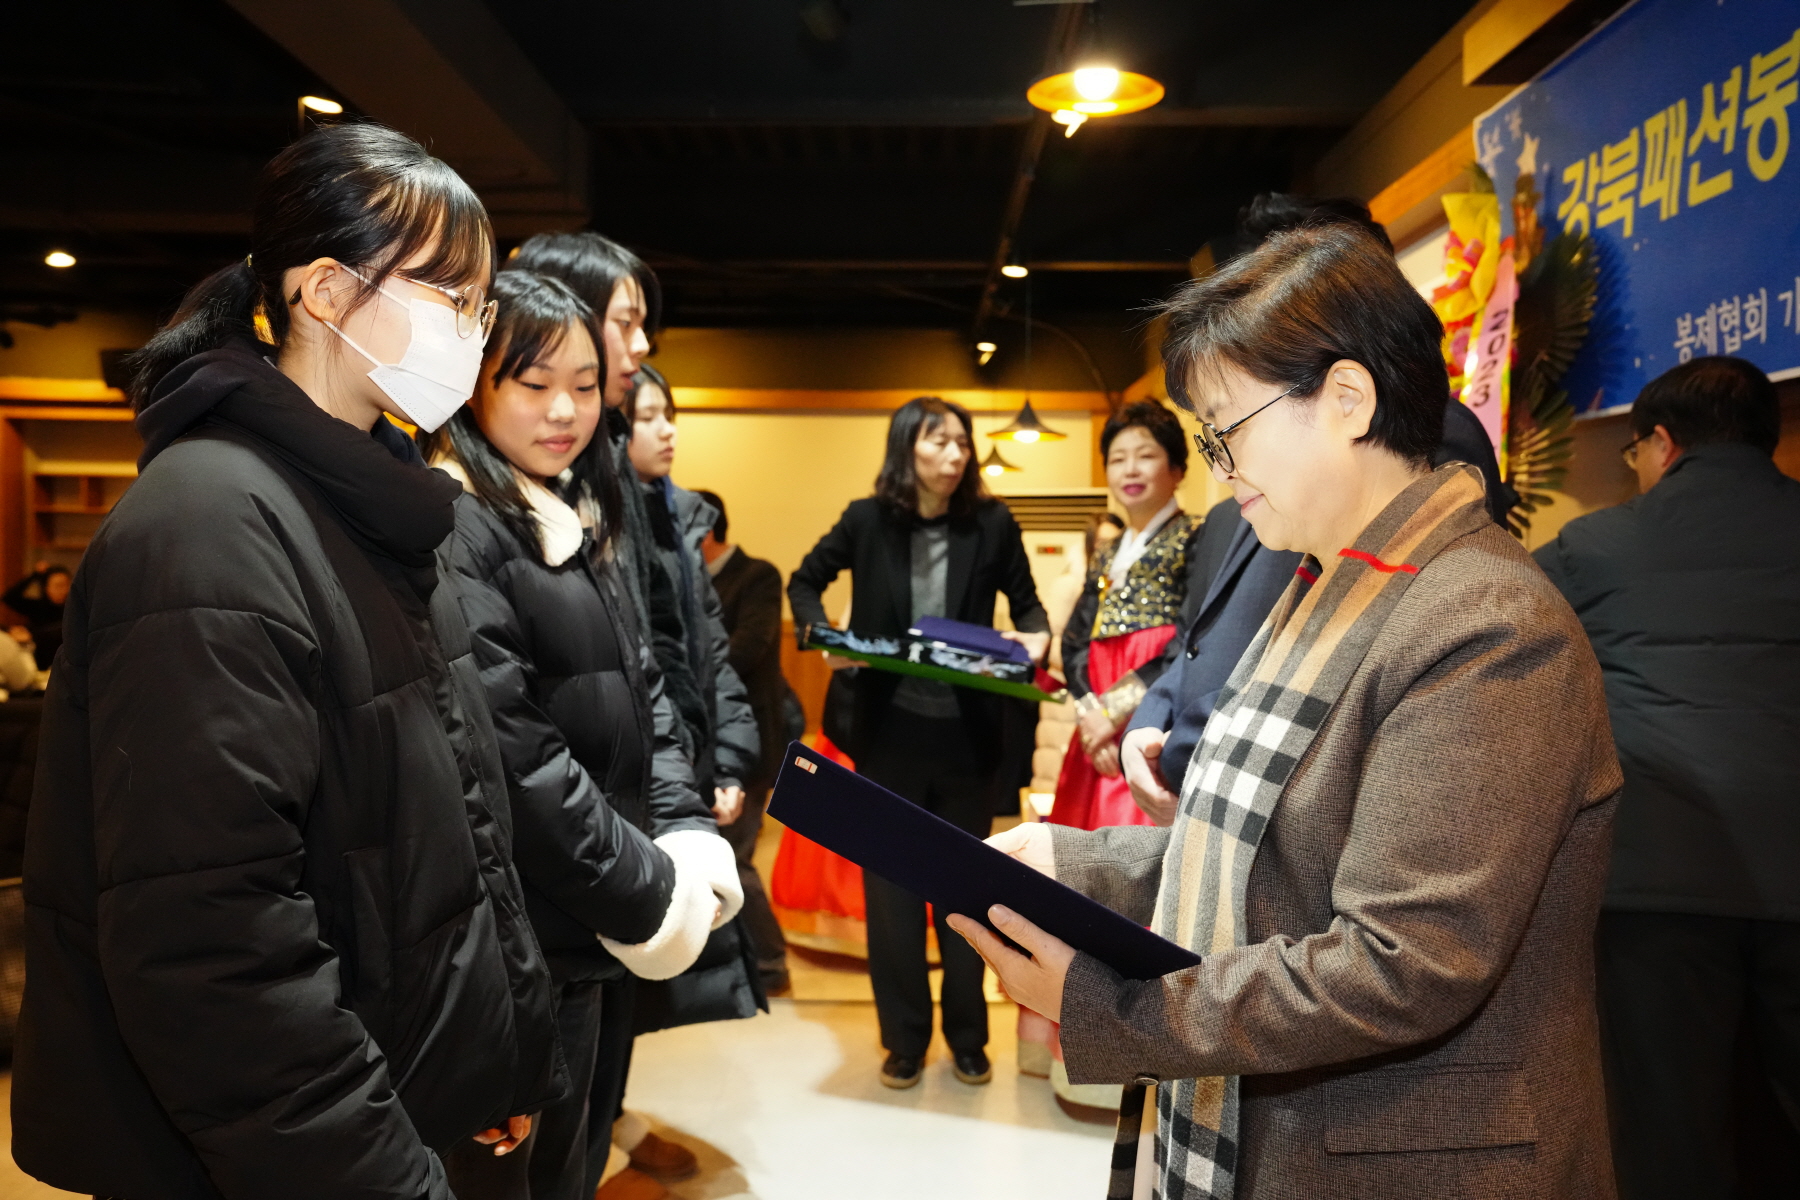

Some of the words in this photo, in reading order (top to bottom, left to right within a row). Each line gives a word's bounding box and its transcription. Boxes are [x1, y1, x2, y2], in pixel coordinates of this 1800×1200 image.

[1557, 28, 1800, 241] 강북패션봉
[1472, 308, 1509, 408] 2023
[1673, 286, 1768, 364] 봉제협회
